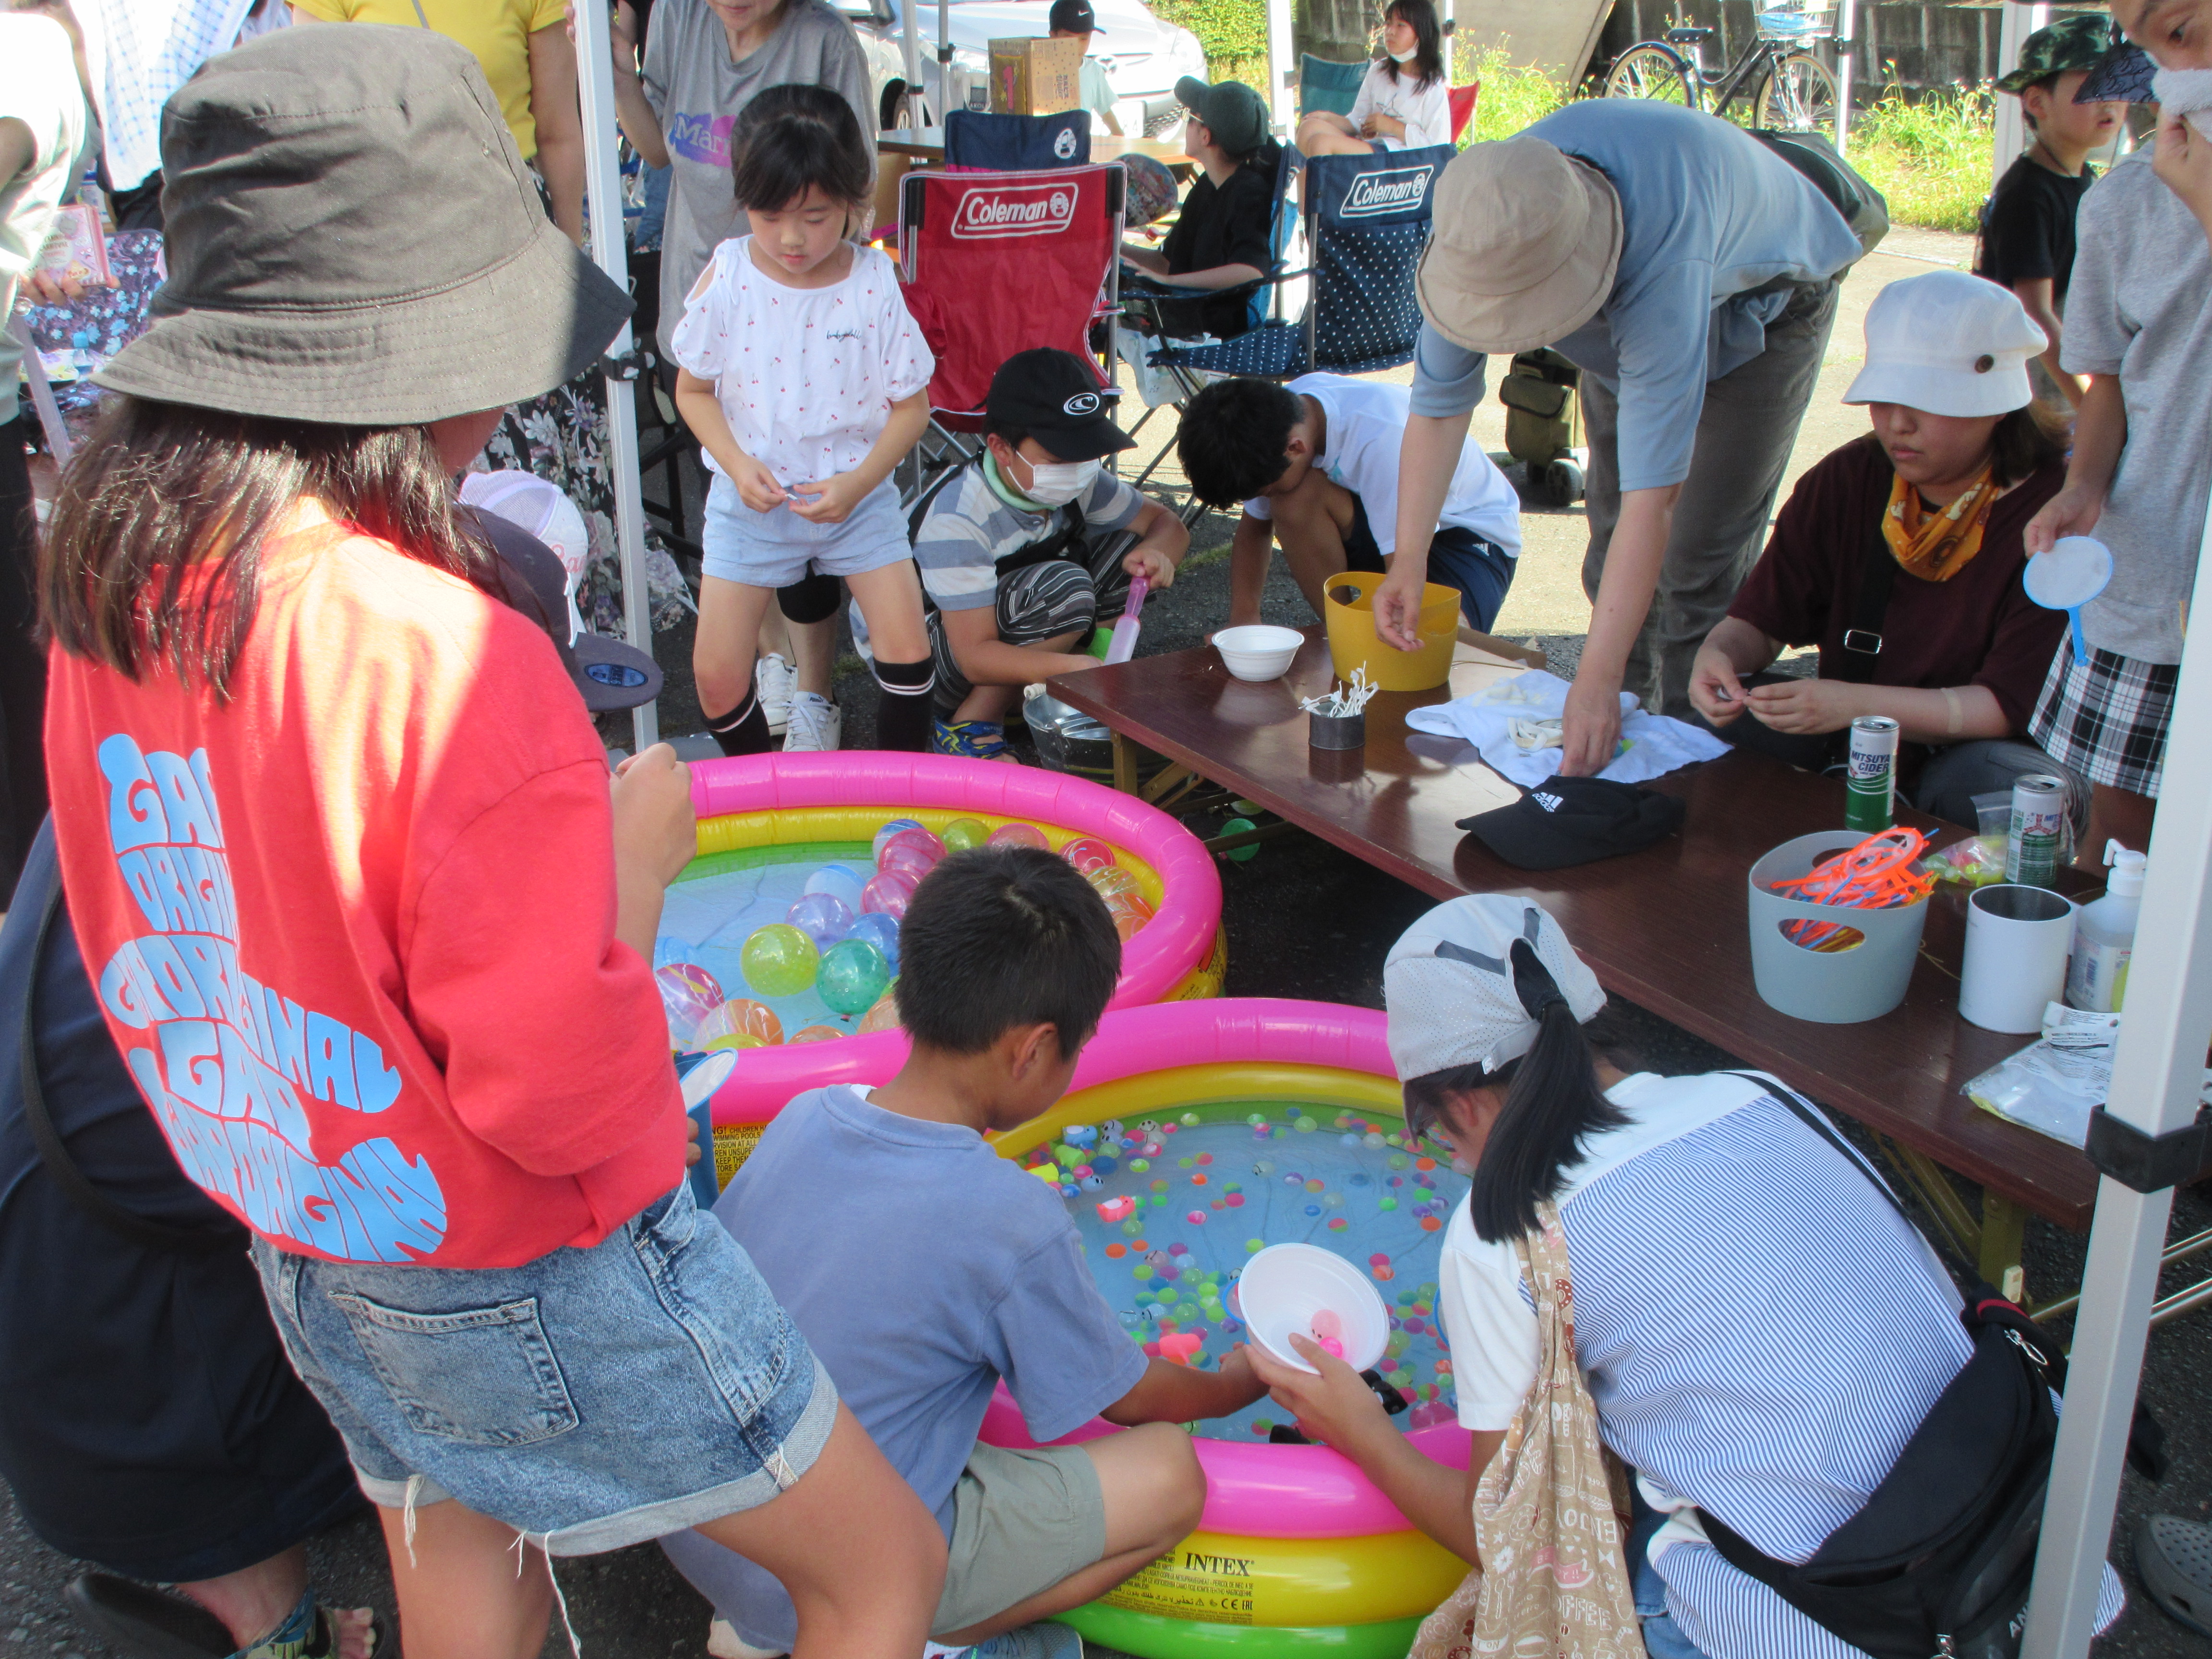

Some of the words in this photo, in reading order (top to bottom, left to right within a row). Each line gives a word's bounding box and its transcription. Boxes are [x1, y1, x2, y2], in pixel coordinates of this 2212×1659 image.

[1353, 178, 1413, 206] Coleman
[967, 196, 1048, 225] Coleman
[1851, 750, 1890, 764] MITSUYA
[1859, 762, 1890, 773] CIDER
[741, 1131, 761, 1140] POOLS
[715, 1157, 732, 1165] KEEP
[1184, 1552, 1250, 1577] INTEX
